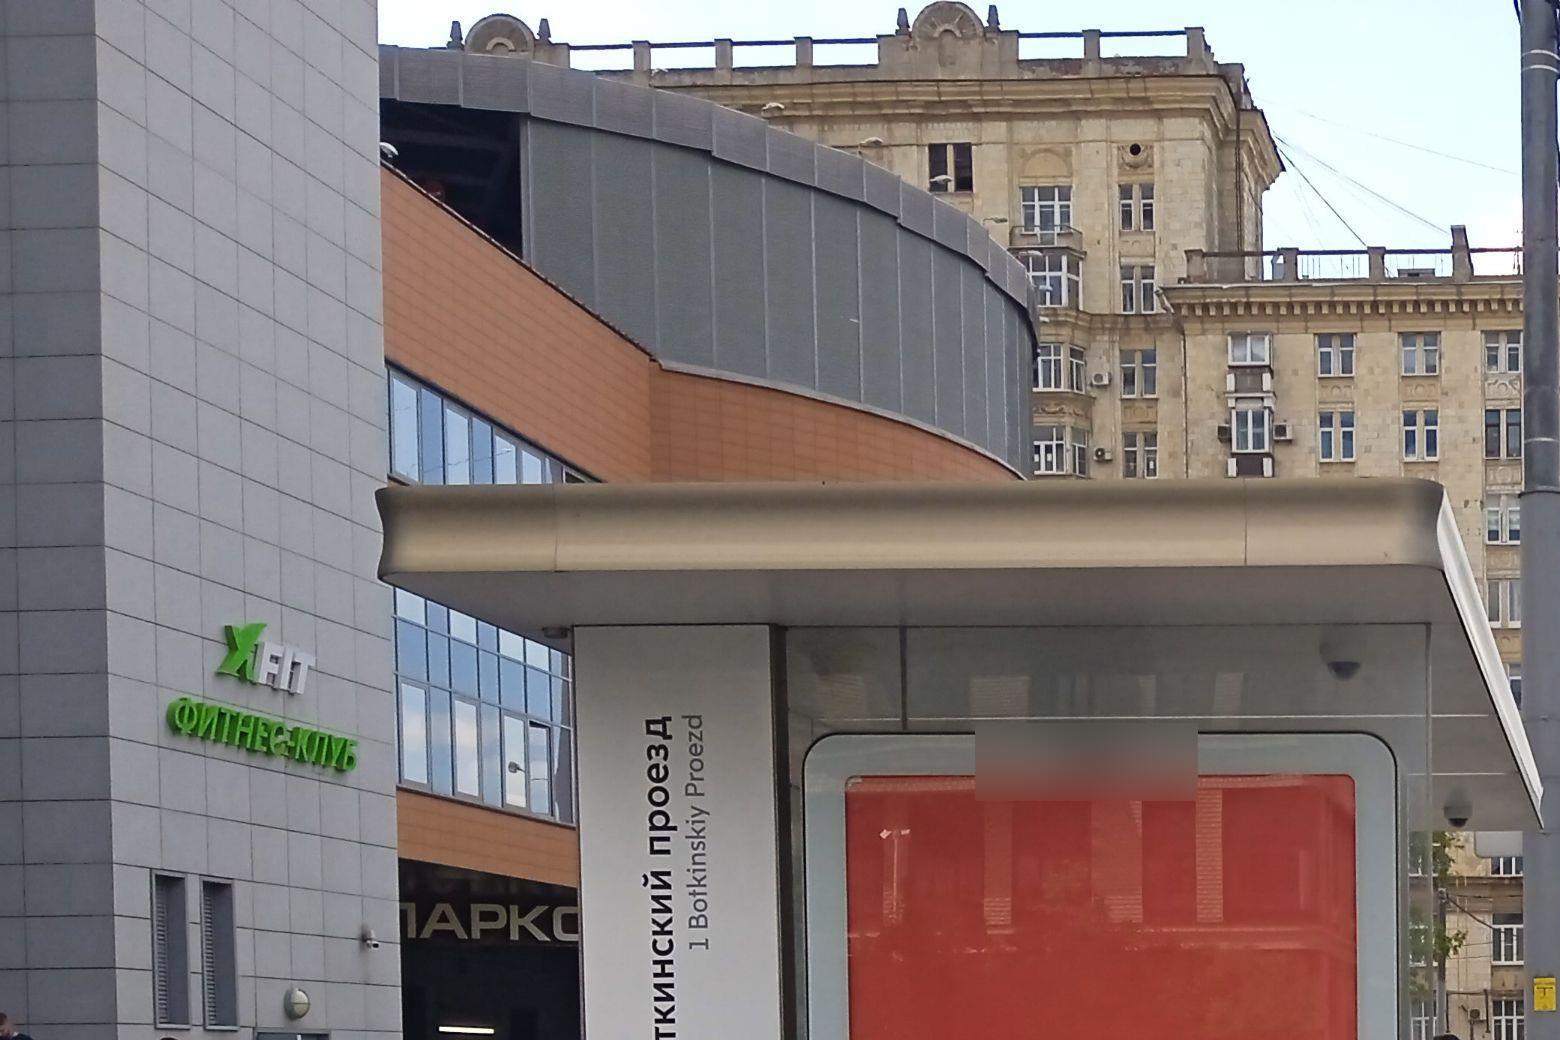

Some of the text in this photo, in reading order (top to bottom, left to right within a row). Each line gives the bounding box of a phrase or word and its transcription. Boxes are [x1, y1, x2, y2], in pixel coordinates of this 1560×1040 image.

[167, 697, 358, 771] ФИТНЕС-КЛУБ
[645, 715, 678, 856] проезд
[681, 714, 710, 951] 1 Botkinskiy Proezd
